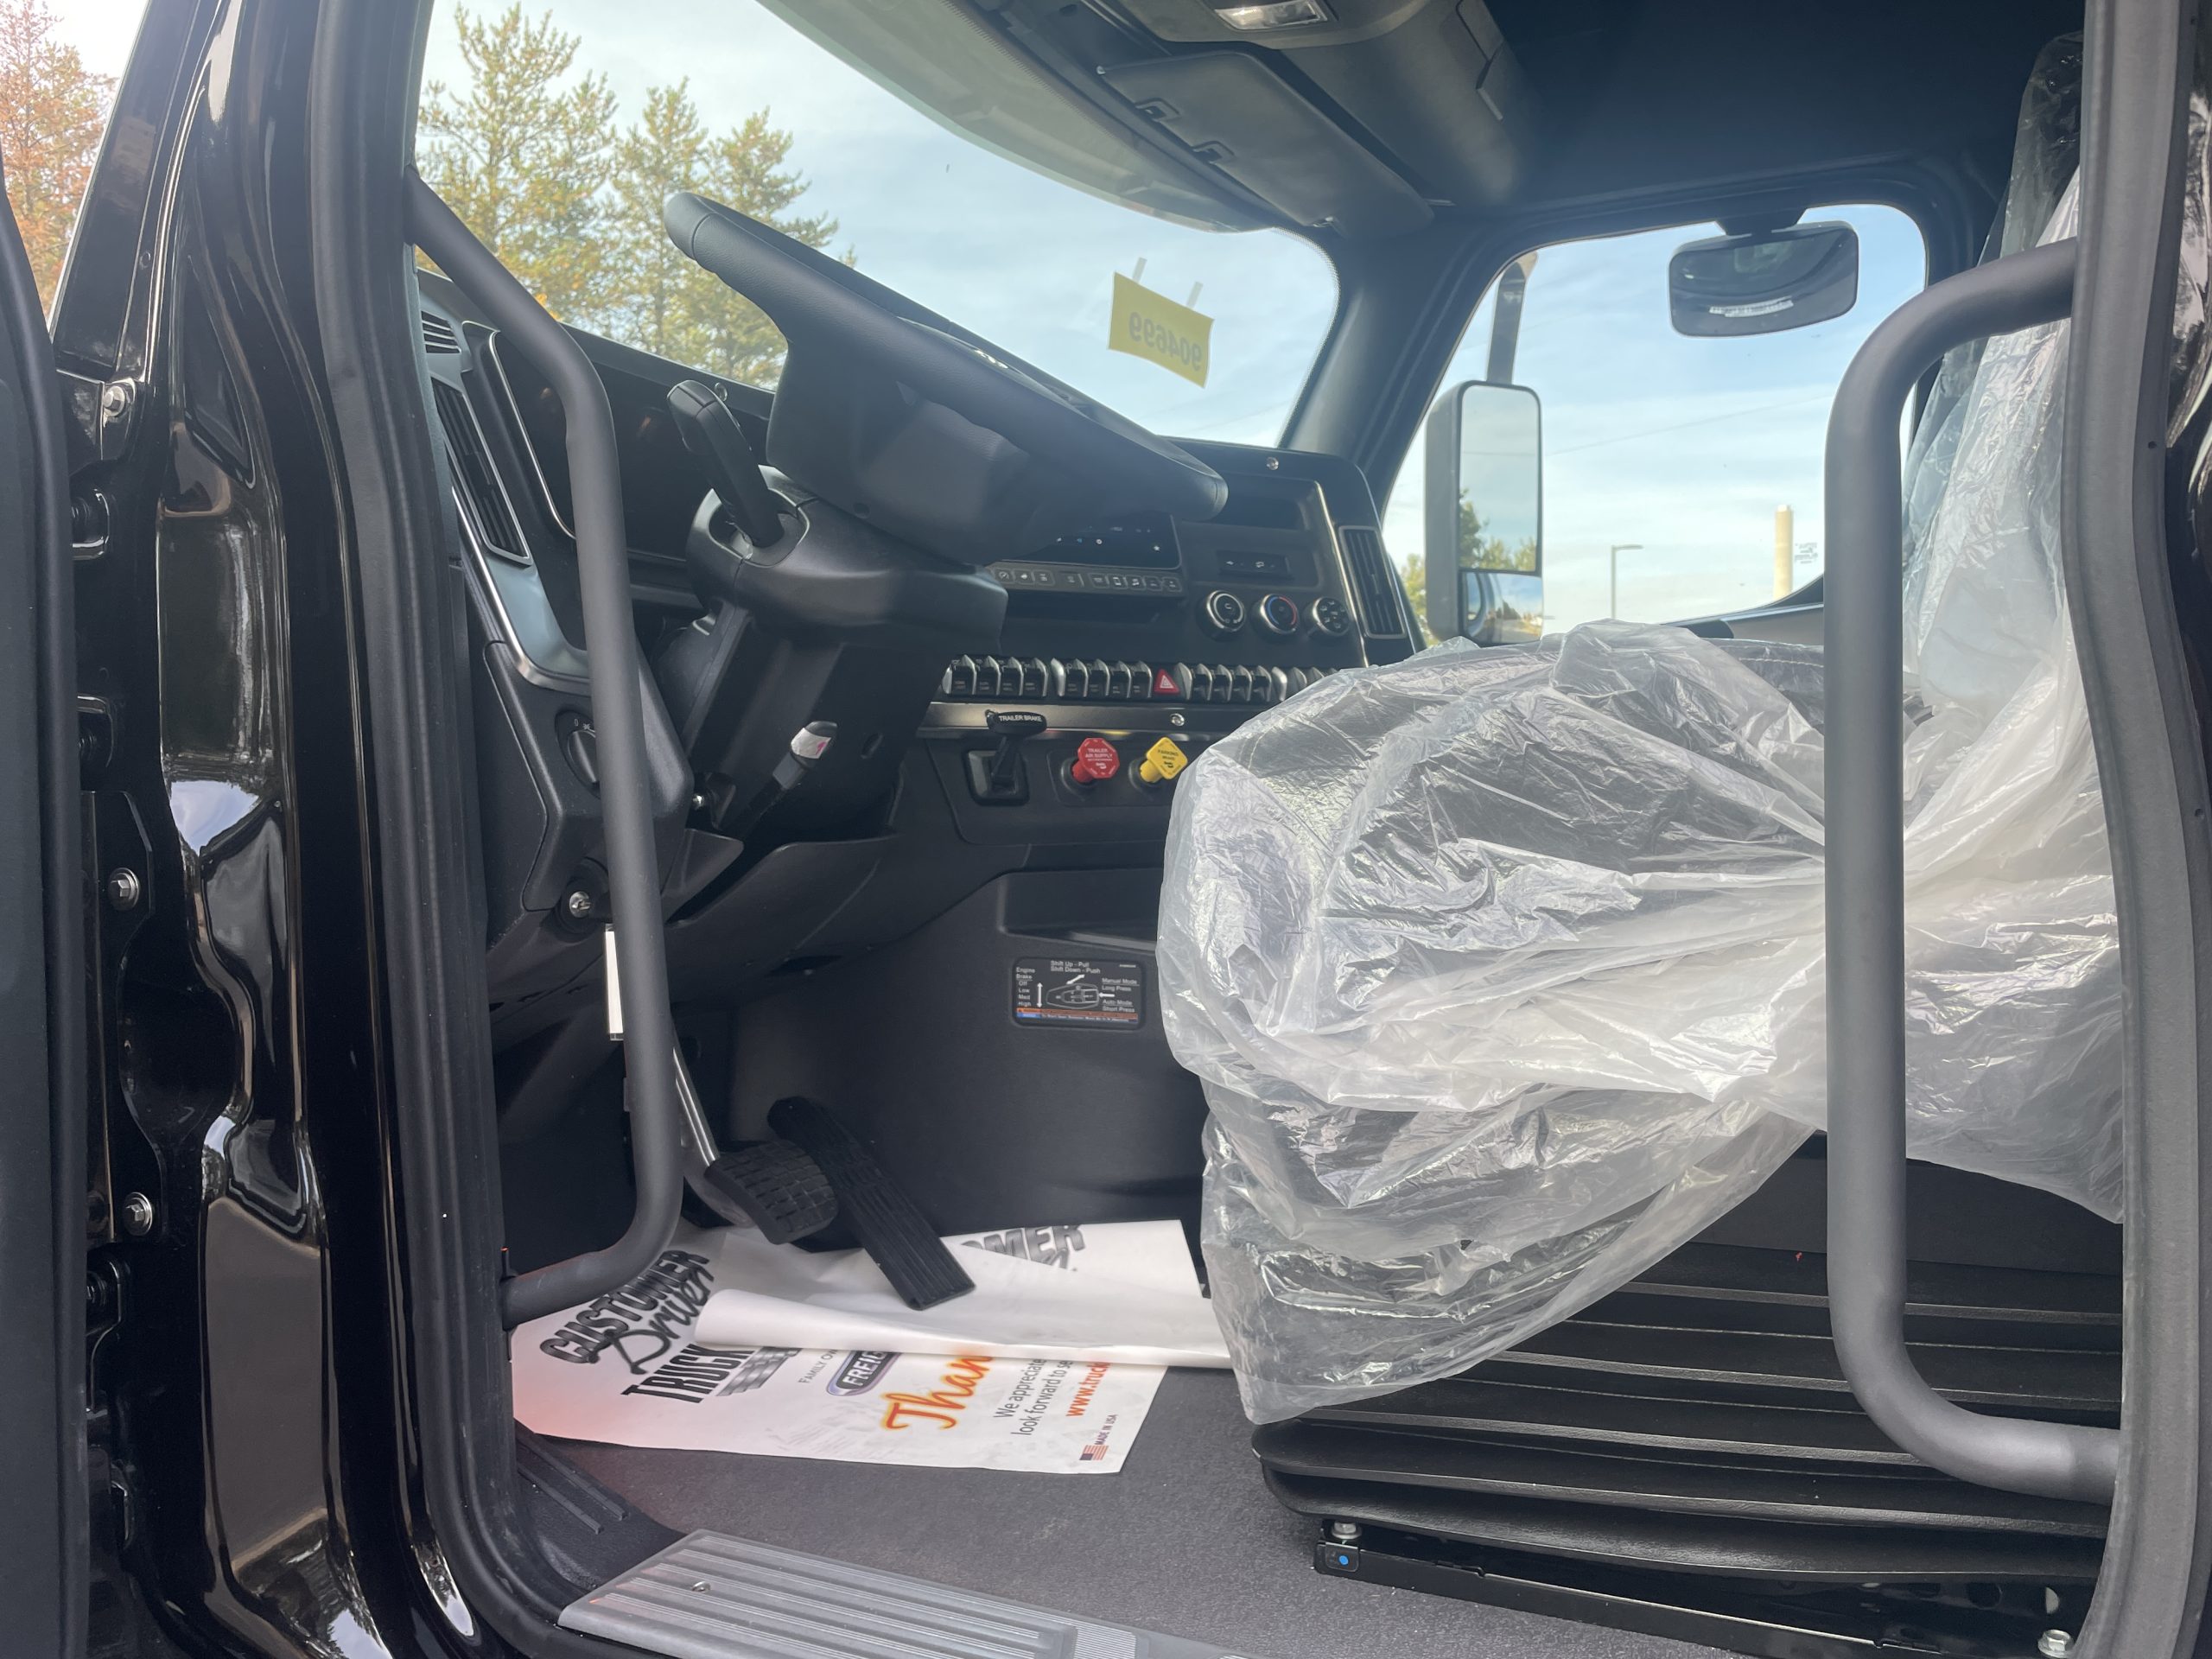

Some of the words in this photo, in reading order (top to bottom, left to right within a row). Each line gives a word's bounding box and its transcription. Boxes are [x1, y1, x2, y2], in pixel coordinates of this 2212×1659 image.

[540, 1250, 709, 1363] CUSTOMER
[588, 1260, 715, 1375] Driven
[620, 1344, 754, 1403] TRUCK
[798, 1361, 826, 1383] FAMILY
[1049, 1369, 1067, 1379] to
[882, 1356, 995, 1430] Than
[994, 1402, 1020, 1418] We
[1024, 1378, 1062, 1414] forward
[1010, 1415, 1042, 1435] look
[1094, 1431, 1110, 1446] MADE
[1107, 1414, 1119, 1425] USA
